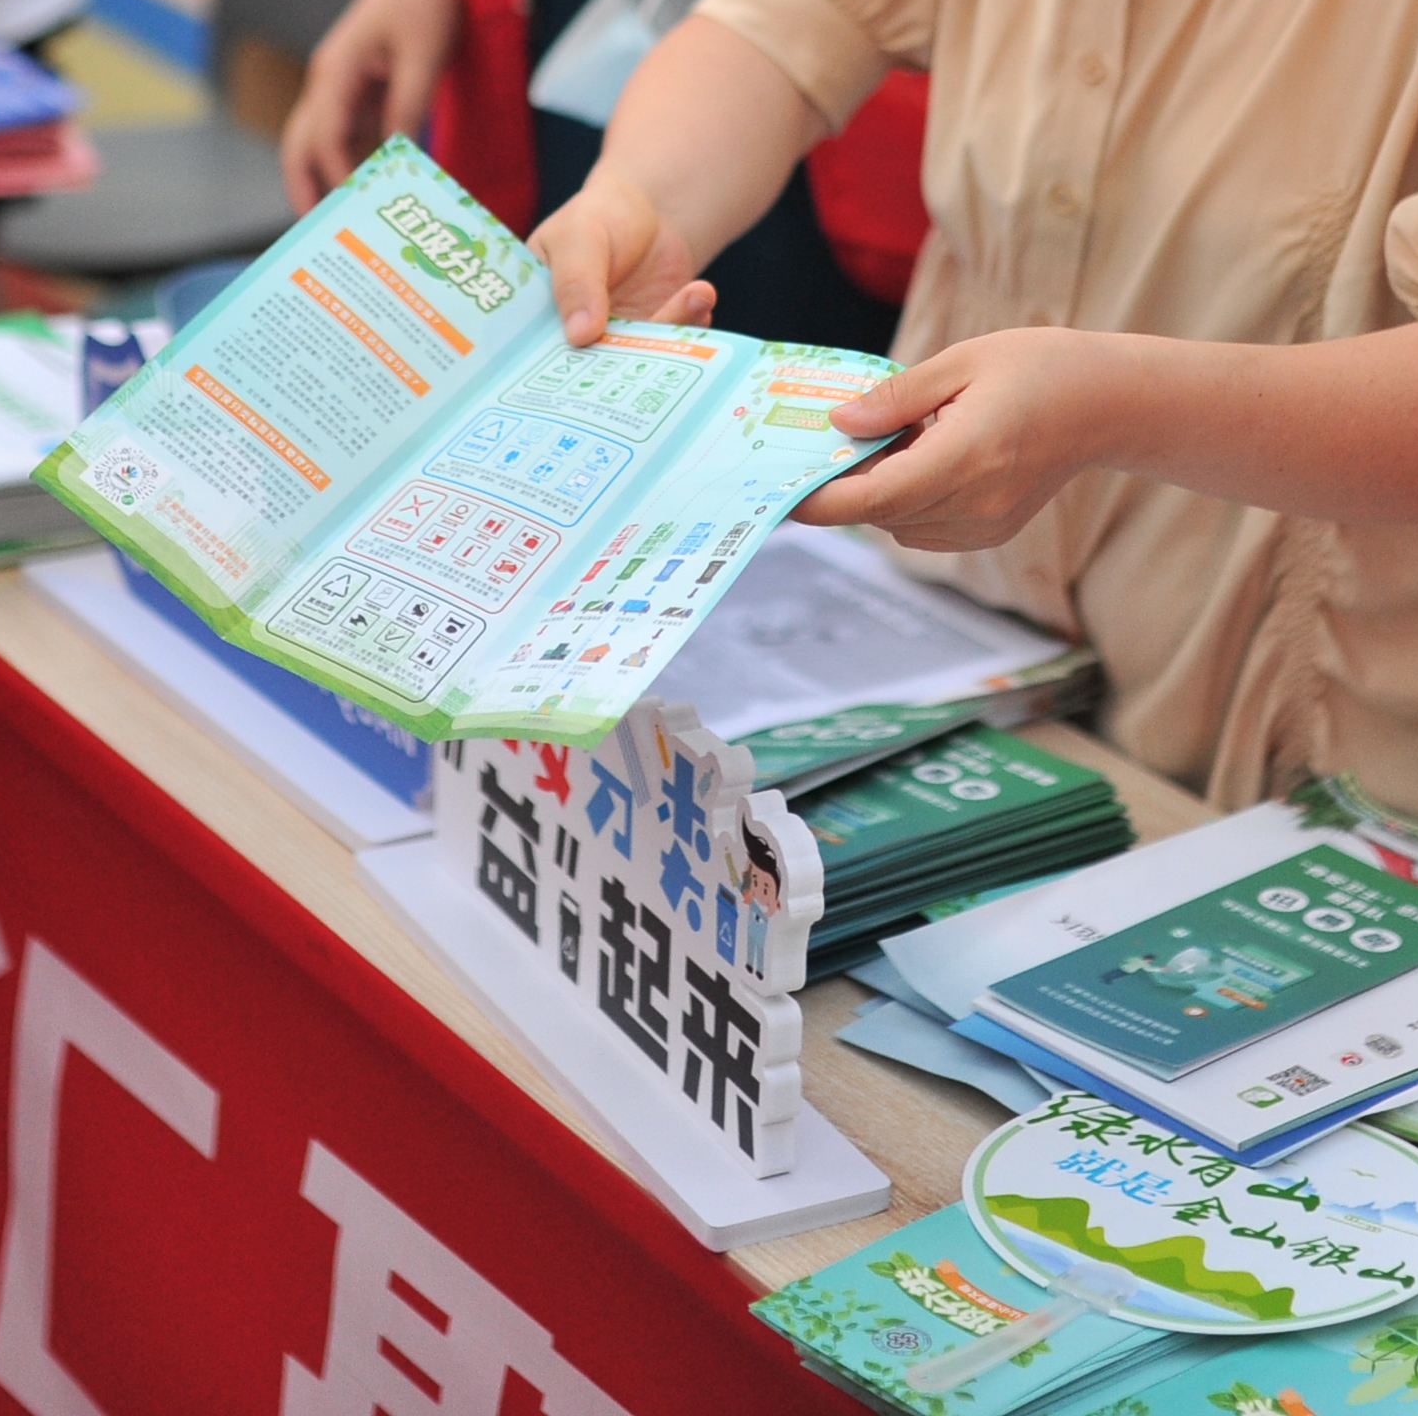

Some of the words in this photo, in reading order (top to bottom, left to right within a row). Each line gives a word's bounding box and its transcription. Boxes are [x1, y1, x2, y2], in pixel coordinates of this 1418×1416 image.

[379, 195, 513, 312] 垃圾分类
[1053, 1148, 1175, 1206] 就是
[1161, 1195, 1417, 1290] 金山银山
[894, 1267, 1021, 1342] 圾分类
